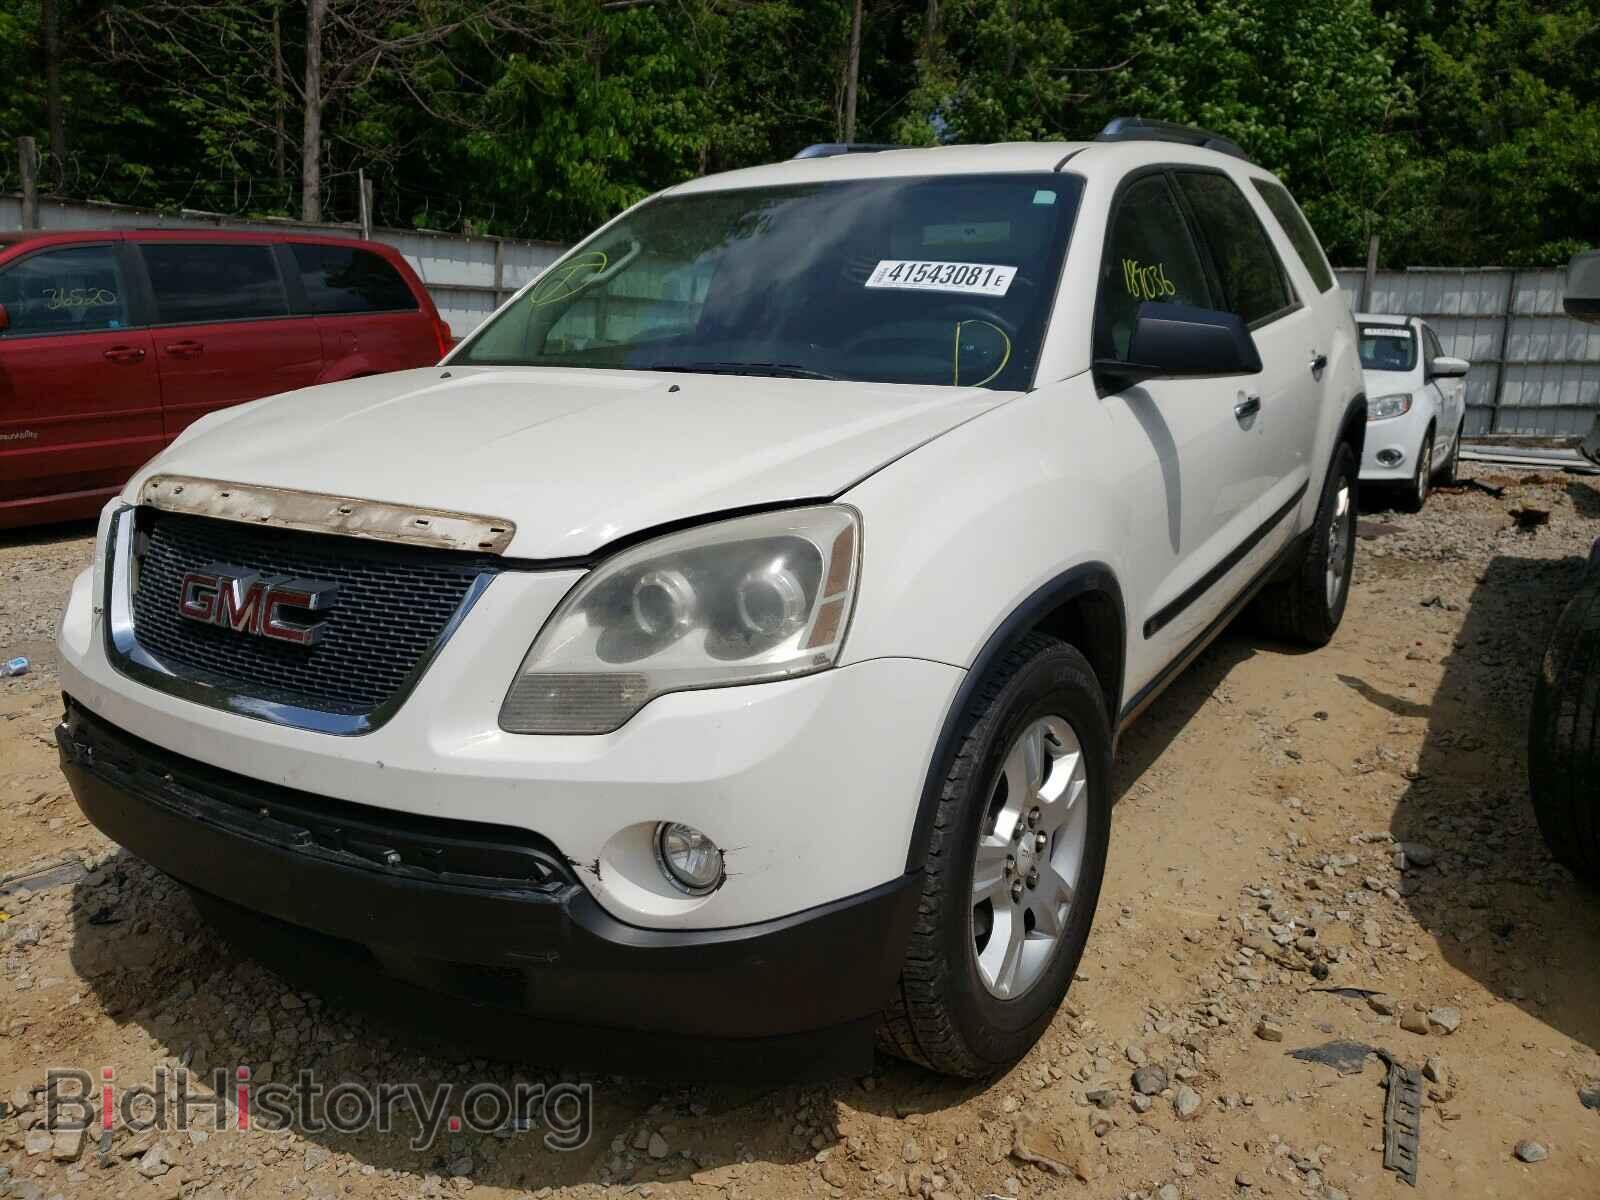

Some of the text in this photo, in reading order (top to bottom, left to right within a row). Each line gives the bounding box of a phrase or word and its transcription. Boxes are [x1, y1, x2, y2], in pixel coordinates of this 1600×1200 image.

[888, 262, 995, 287] 41543081
[993, 274, 1008, 287] E
[179, 565, 334, 646] GMC
